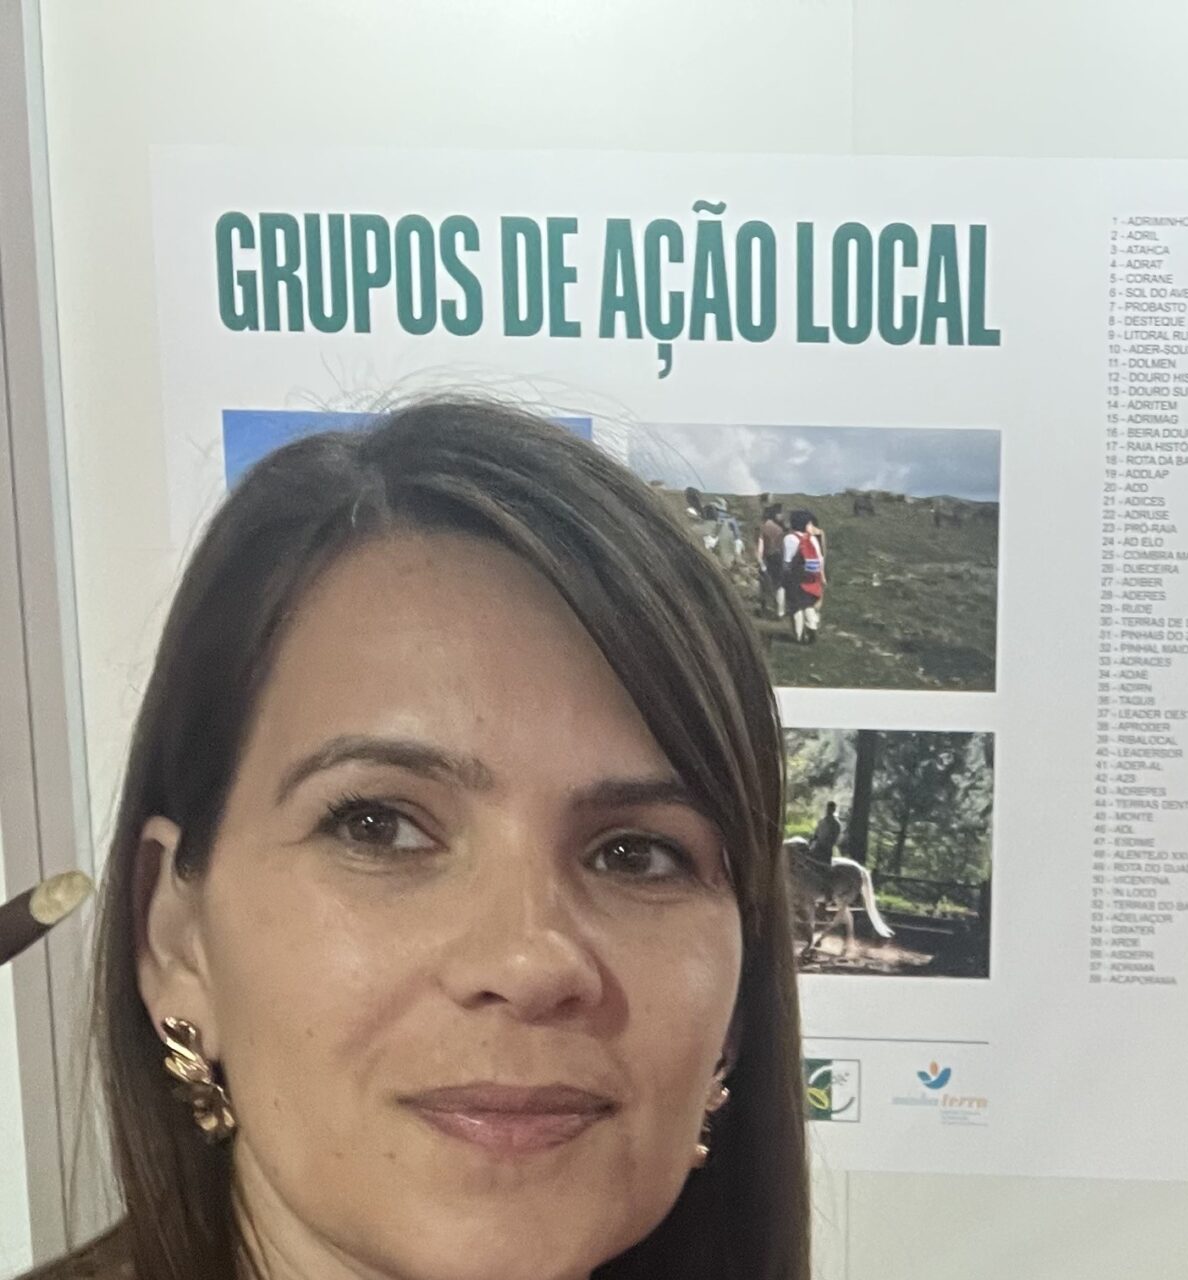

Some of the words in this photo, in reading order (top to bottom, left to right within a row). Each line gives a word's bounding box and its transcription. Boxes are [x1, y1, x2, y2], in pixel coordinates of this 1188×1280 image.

[1127, 231, 1159, 242] ADRIL
[1126, 245, 1170, 256] ATAHCA
[1126, 259, 1163, 270] ADRAT
[1125, 274, 1173, 285] CORANE
[215, 210, 484, 336] GRUPOS
[501, 215, 581, 338] DE
[598, 199, 777, 380] AÇÃO
[796, 221, 1001, 347] LOCAL
[1125, 288, 1147, 299] SOL
[1149, 289, 1166, 299] DO
[1124, 301, 1187, 312] PROBASTO
[1124, 315, 1186, 326] DESTEQUE
[1123, 330, 1169, 341] LITORAL
[1109, 344, 1121, 354] 10
[1108, 358, 1121, 368] 11
[1129, 358, 1177, 369] DOLMEN
[1108, 372, 1121, 382] 12
[1129, 372, 1171, 383] DOURO
[1108, 386, 1120, 396] 13
[1128, 386, 1170, 397] DOURO
[1107, 399, 1120, 409] 14
[1128, 399, 1178, 410] ADRITEM
[1107, 413, 1119, 423] 15
[1127, 413, 1179, 424] ADRIMAG
[1106, 427, 1119, 437] 16
[1127, 427, 1160, 438] BEIRA
[1106, 441, 1119, 451] 17
[1127, 441, 1153, 452] RAIA
